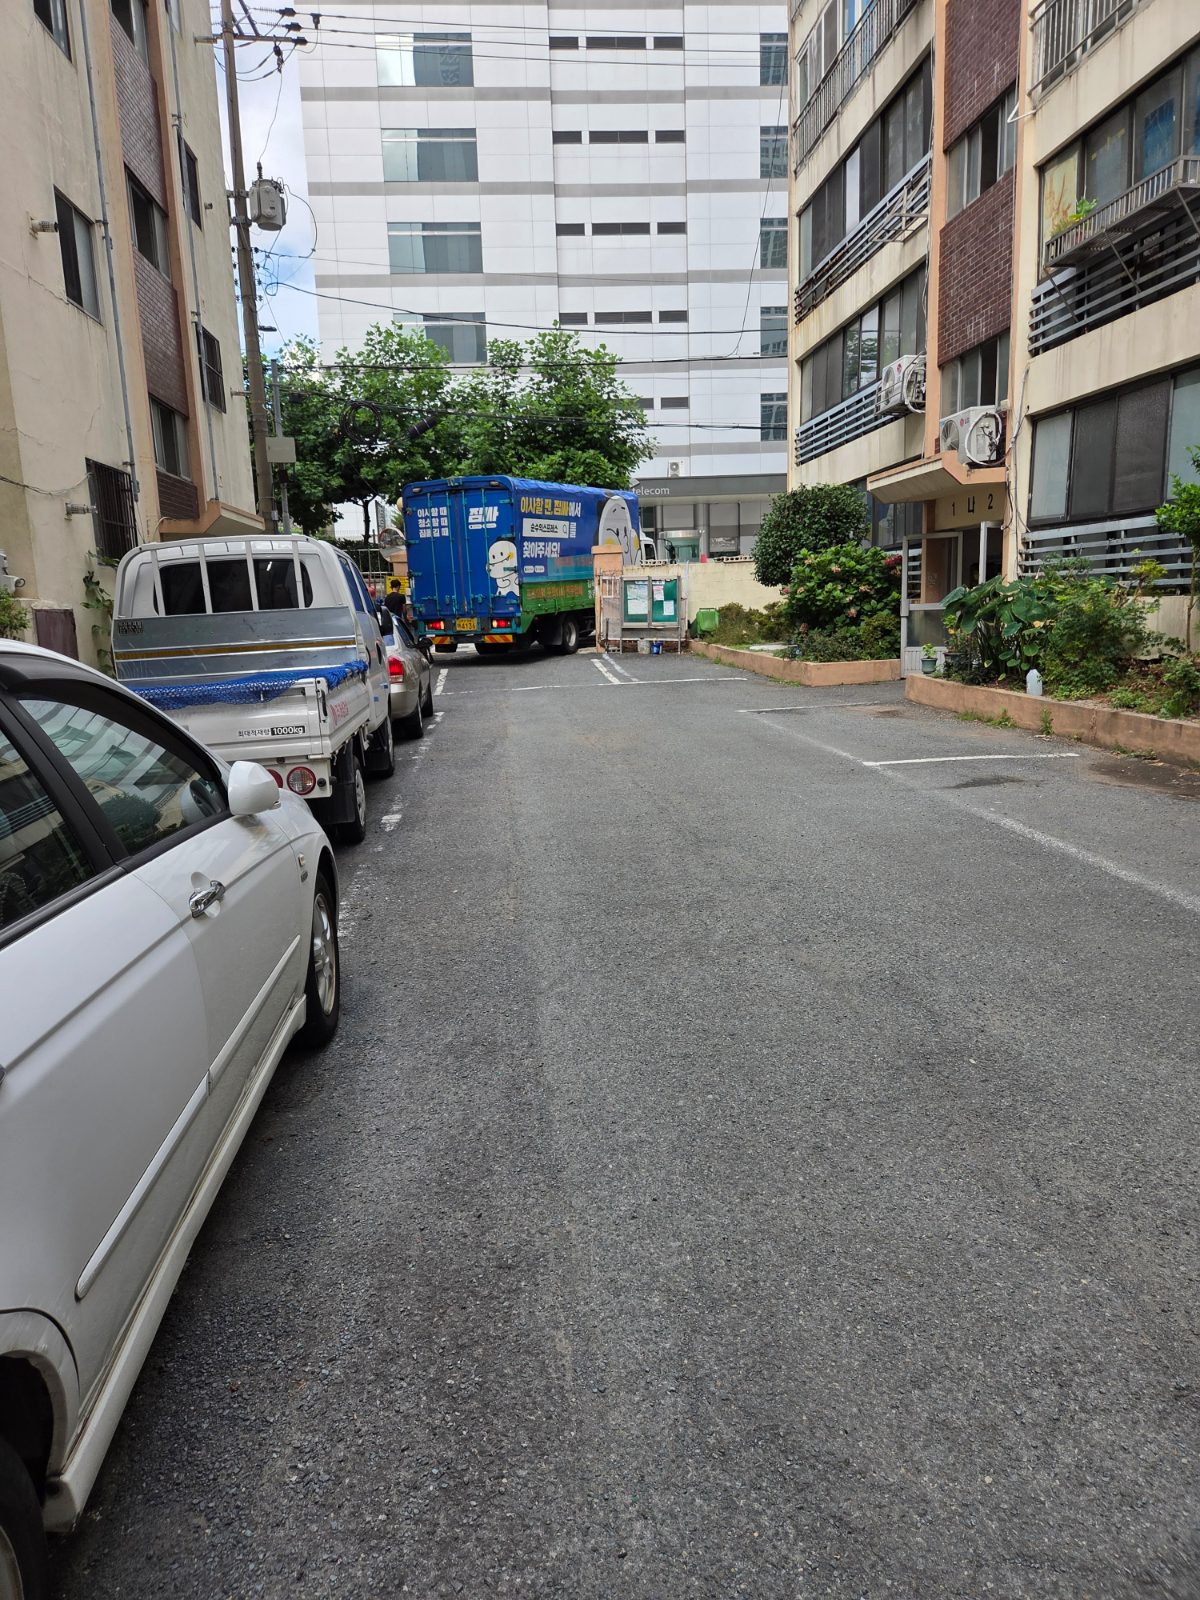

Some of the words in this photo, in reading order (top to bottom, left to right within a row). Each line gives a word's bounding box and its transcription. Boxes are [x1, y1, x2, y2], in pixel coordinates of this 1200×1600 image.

[520, 496, 543, 515] 이사할
[417, 507, 438, 518] 이사할
[439, 506, 447, 516] 때
[418, 517, 439, 528] 청소할
[440, 517, 448, 526] 때
[441, 527, 449, 537] 때
[522, 541, 560, 559] 찾아주세요!
[272, 726, 304, 735] 1000kg
